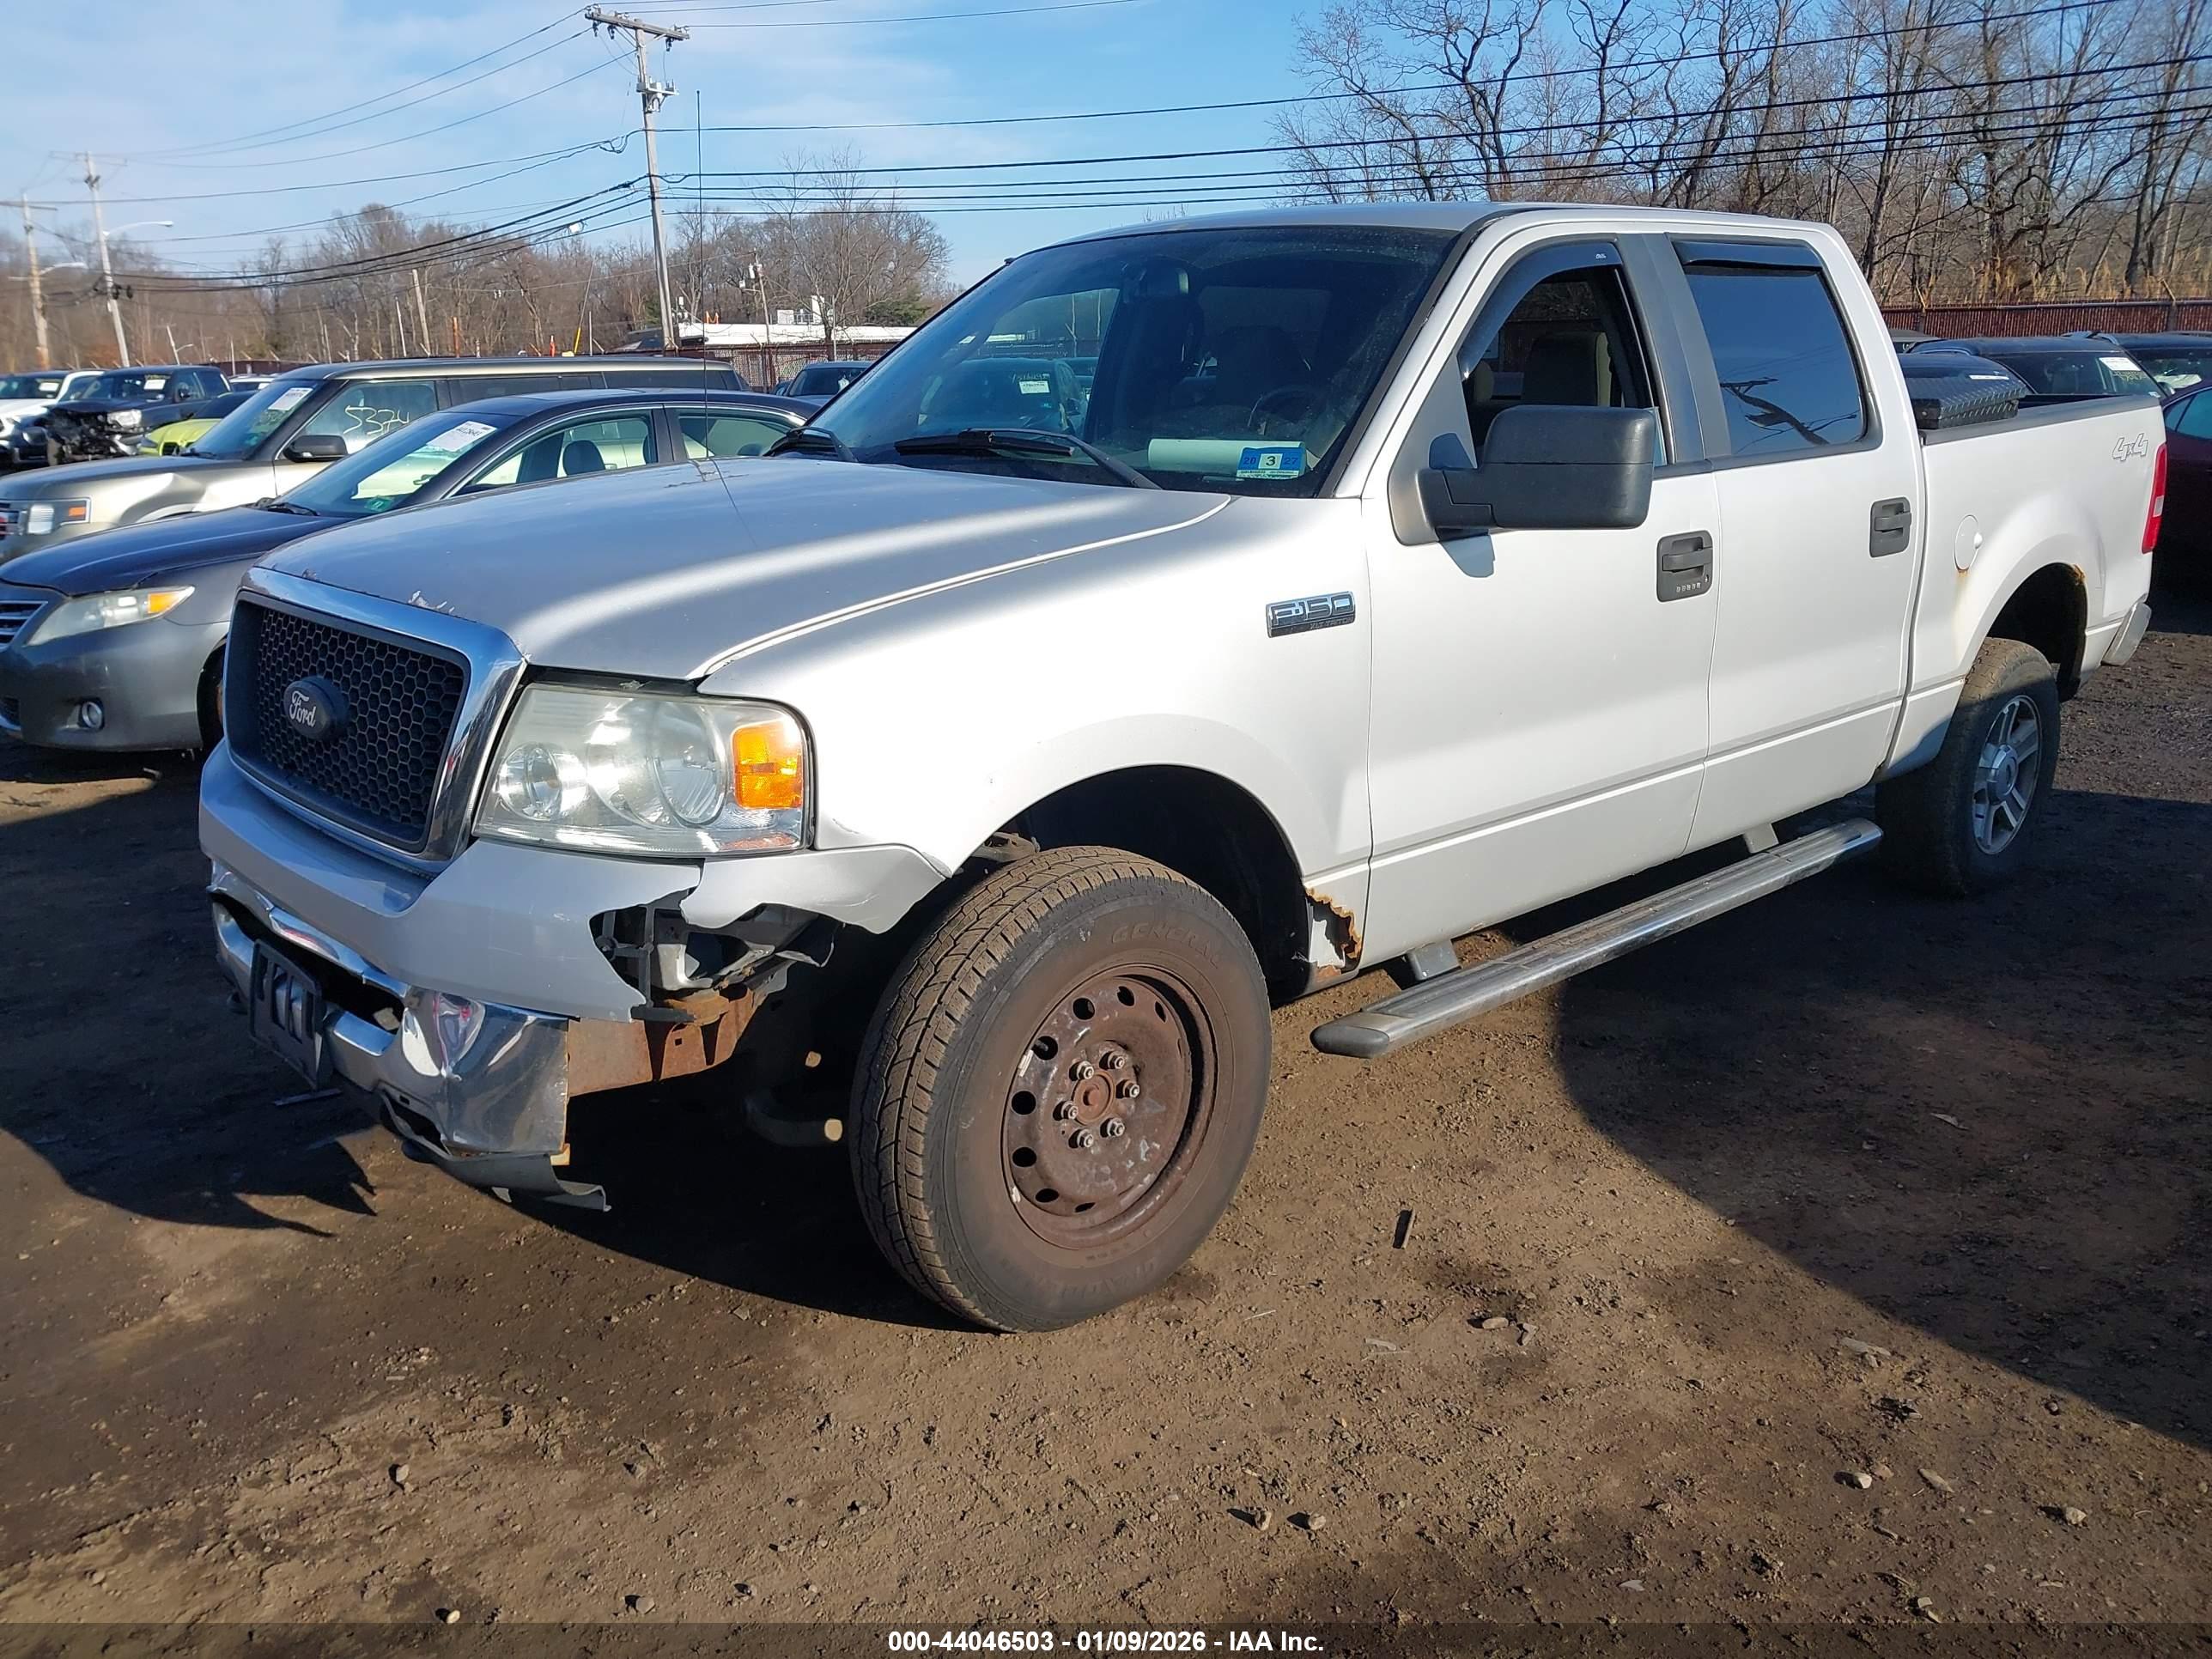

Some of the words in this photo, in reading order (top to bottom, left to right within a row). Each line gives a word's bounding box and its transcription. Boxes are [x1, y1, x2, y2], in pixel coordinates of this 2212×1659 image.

[1266, 455, 1276, 466] 3
[1284, 457, 1299, 465] 27
[2112, 432, 2148, 461] 4x4
[289, 690, 317, 727] Ford
